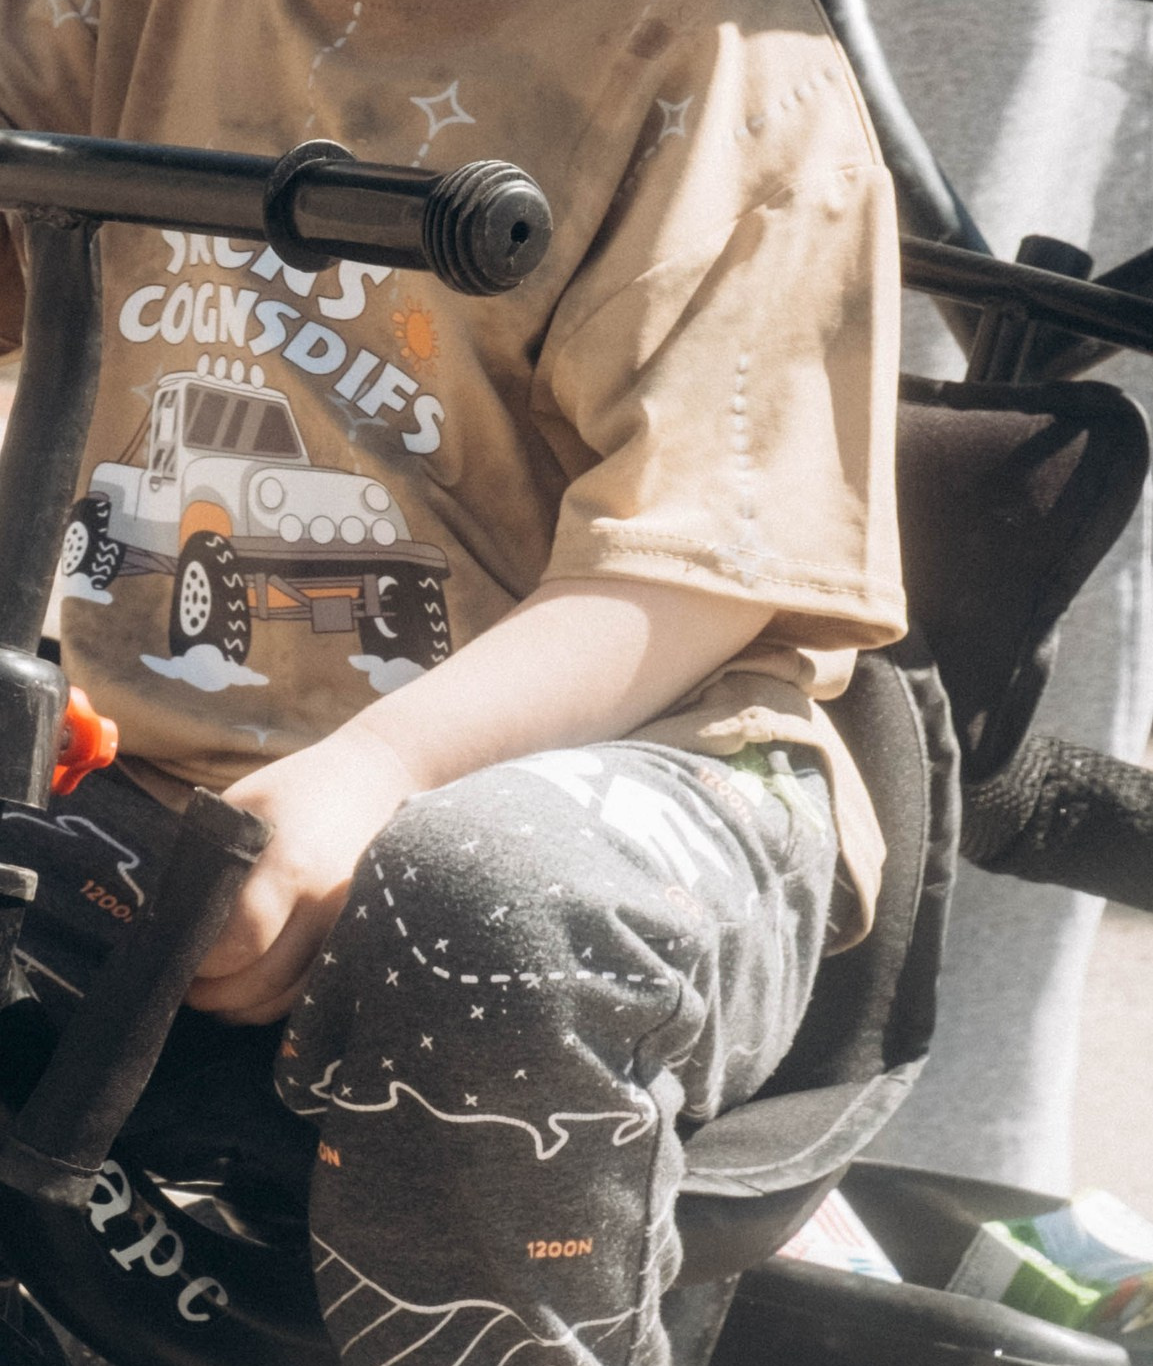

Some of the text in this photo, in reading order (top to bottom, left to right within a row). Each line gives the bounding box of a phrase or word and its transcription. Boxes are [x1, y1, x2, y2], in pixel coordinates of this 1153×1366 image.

[119, 282, 445, 454] COGNSDIFS
[86, 1159, 229, 1322] арс
[527, 1237, 593, 1259] 1200N
